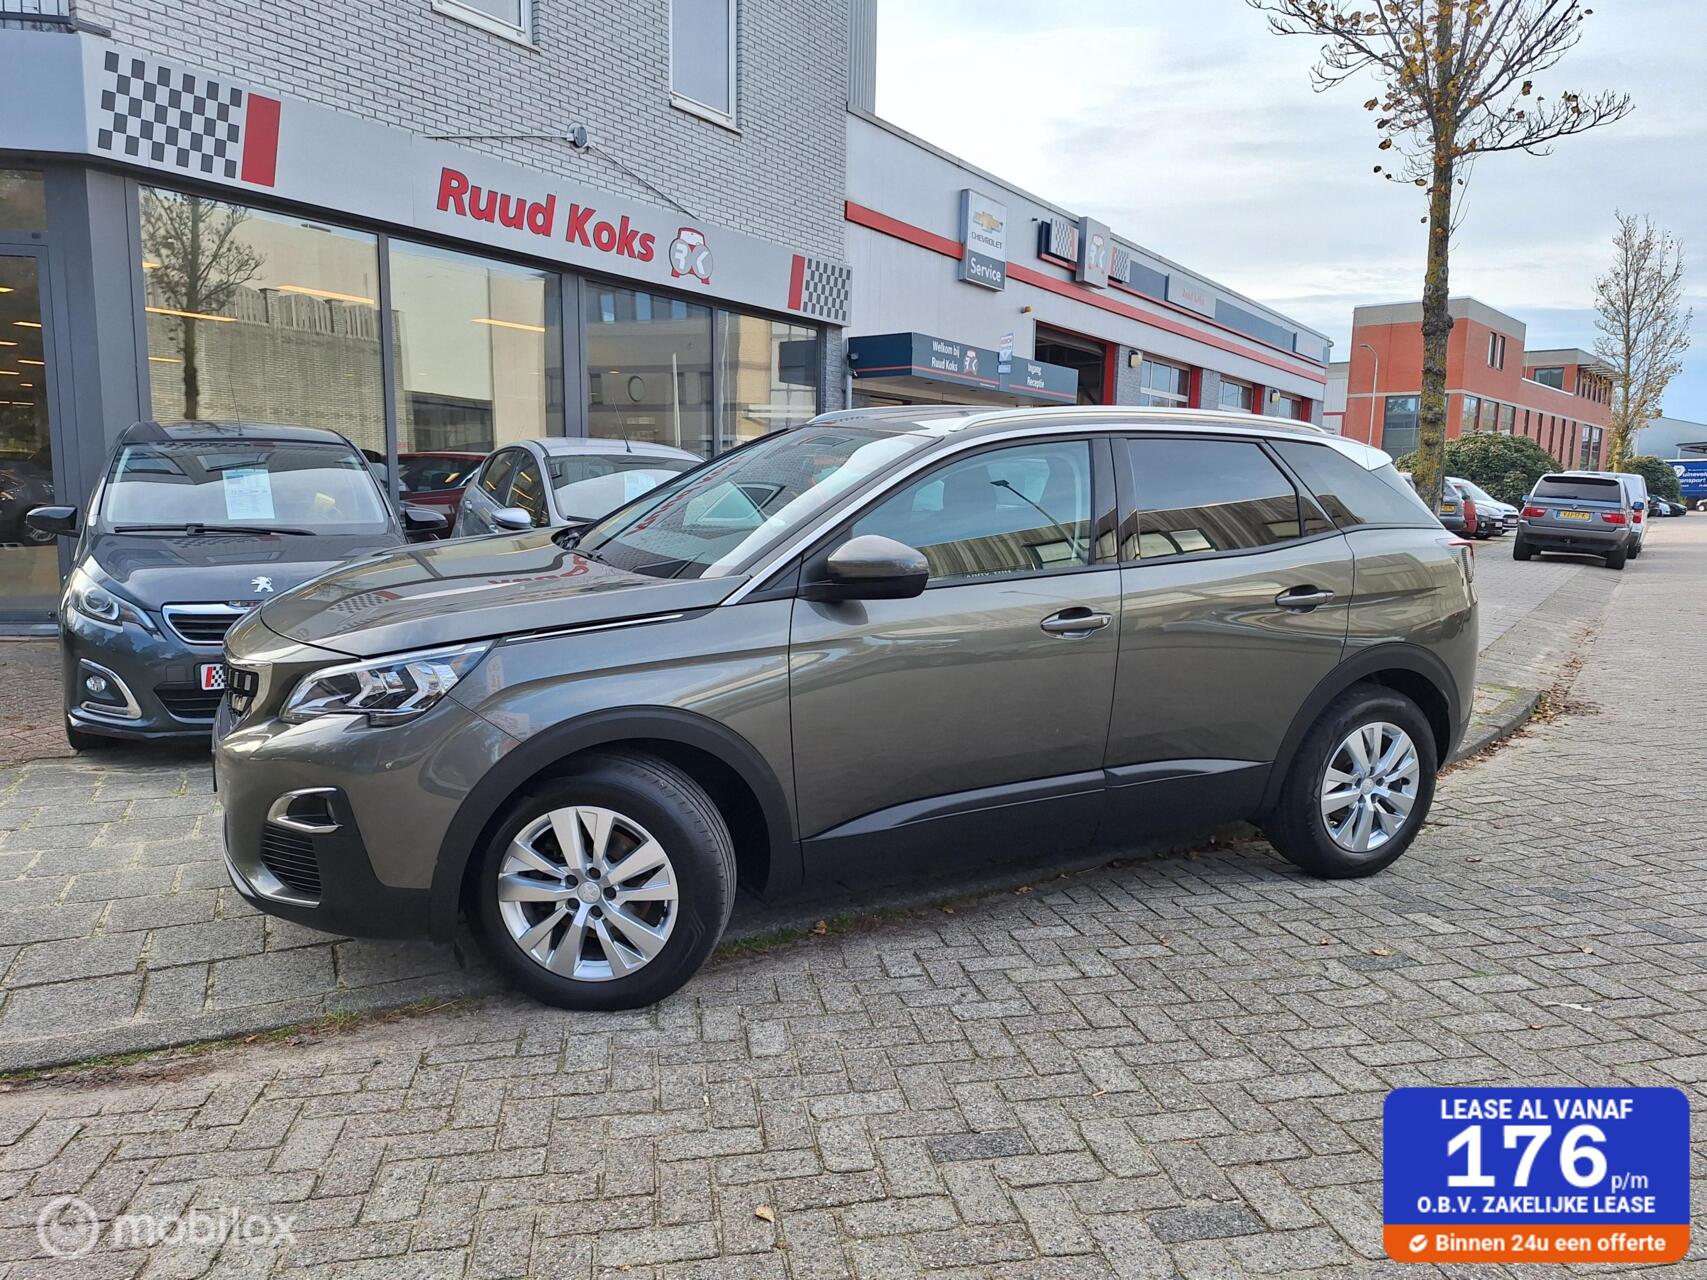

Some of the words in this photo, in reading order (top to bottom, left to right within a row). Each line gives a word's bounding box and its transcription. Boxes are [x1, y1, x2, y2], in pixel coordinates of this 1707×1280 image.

[437, 167, 556, 237] Ruud
[565, 203, 656, 262] Koks
[971, 231, 1002, 249] CHEVROLET
[970, 257, 1001, 282] Service
[932, 340, 953, 355] Welkom
[931, 356, 945, 369] Ruud
[945, 359, 958, 372] Koks
